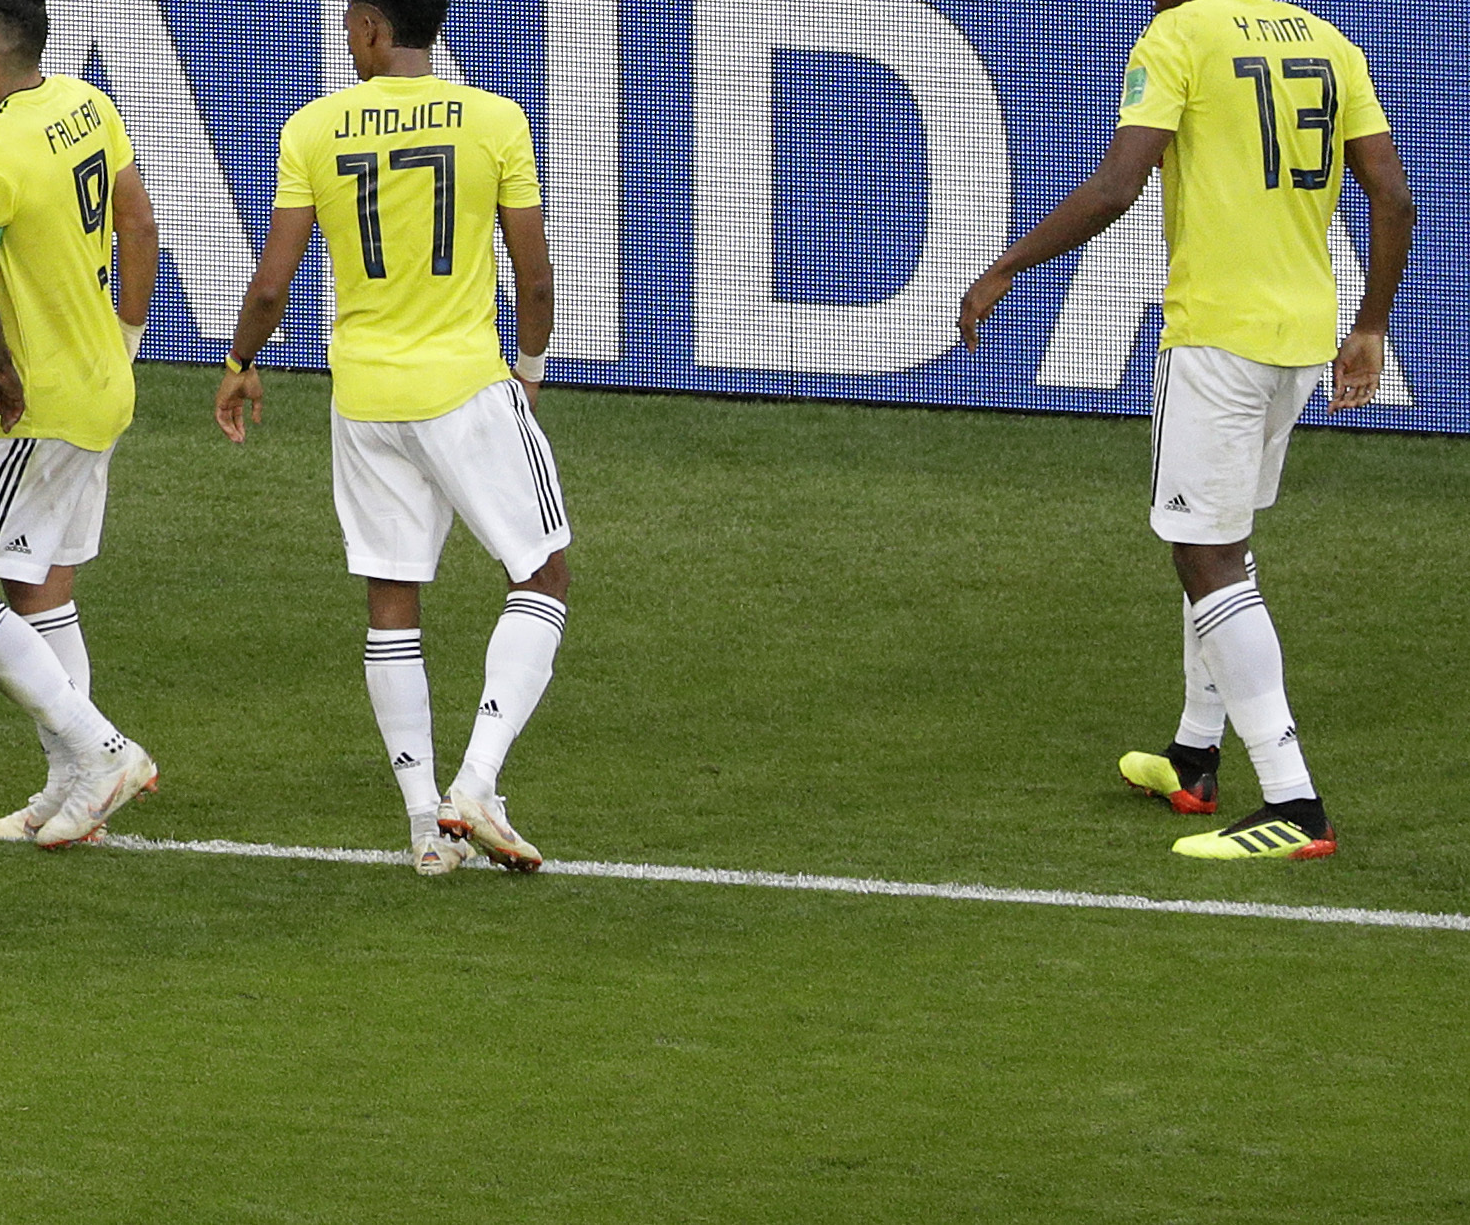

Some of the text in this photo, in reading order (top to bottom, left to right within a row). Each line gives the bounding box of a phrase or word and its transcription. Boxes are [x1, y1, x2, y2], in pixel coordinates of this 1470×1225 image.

[1232, 16, 1316, 43] Y.MINA
[43, 99, 103, 155] FALCAO
[334, 101, 464, 140] J.MOJICA
[1232, 56, 1340, 192] 13
[71, 147, 111, 293] 9
[336, 144, 457, 280] 17
